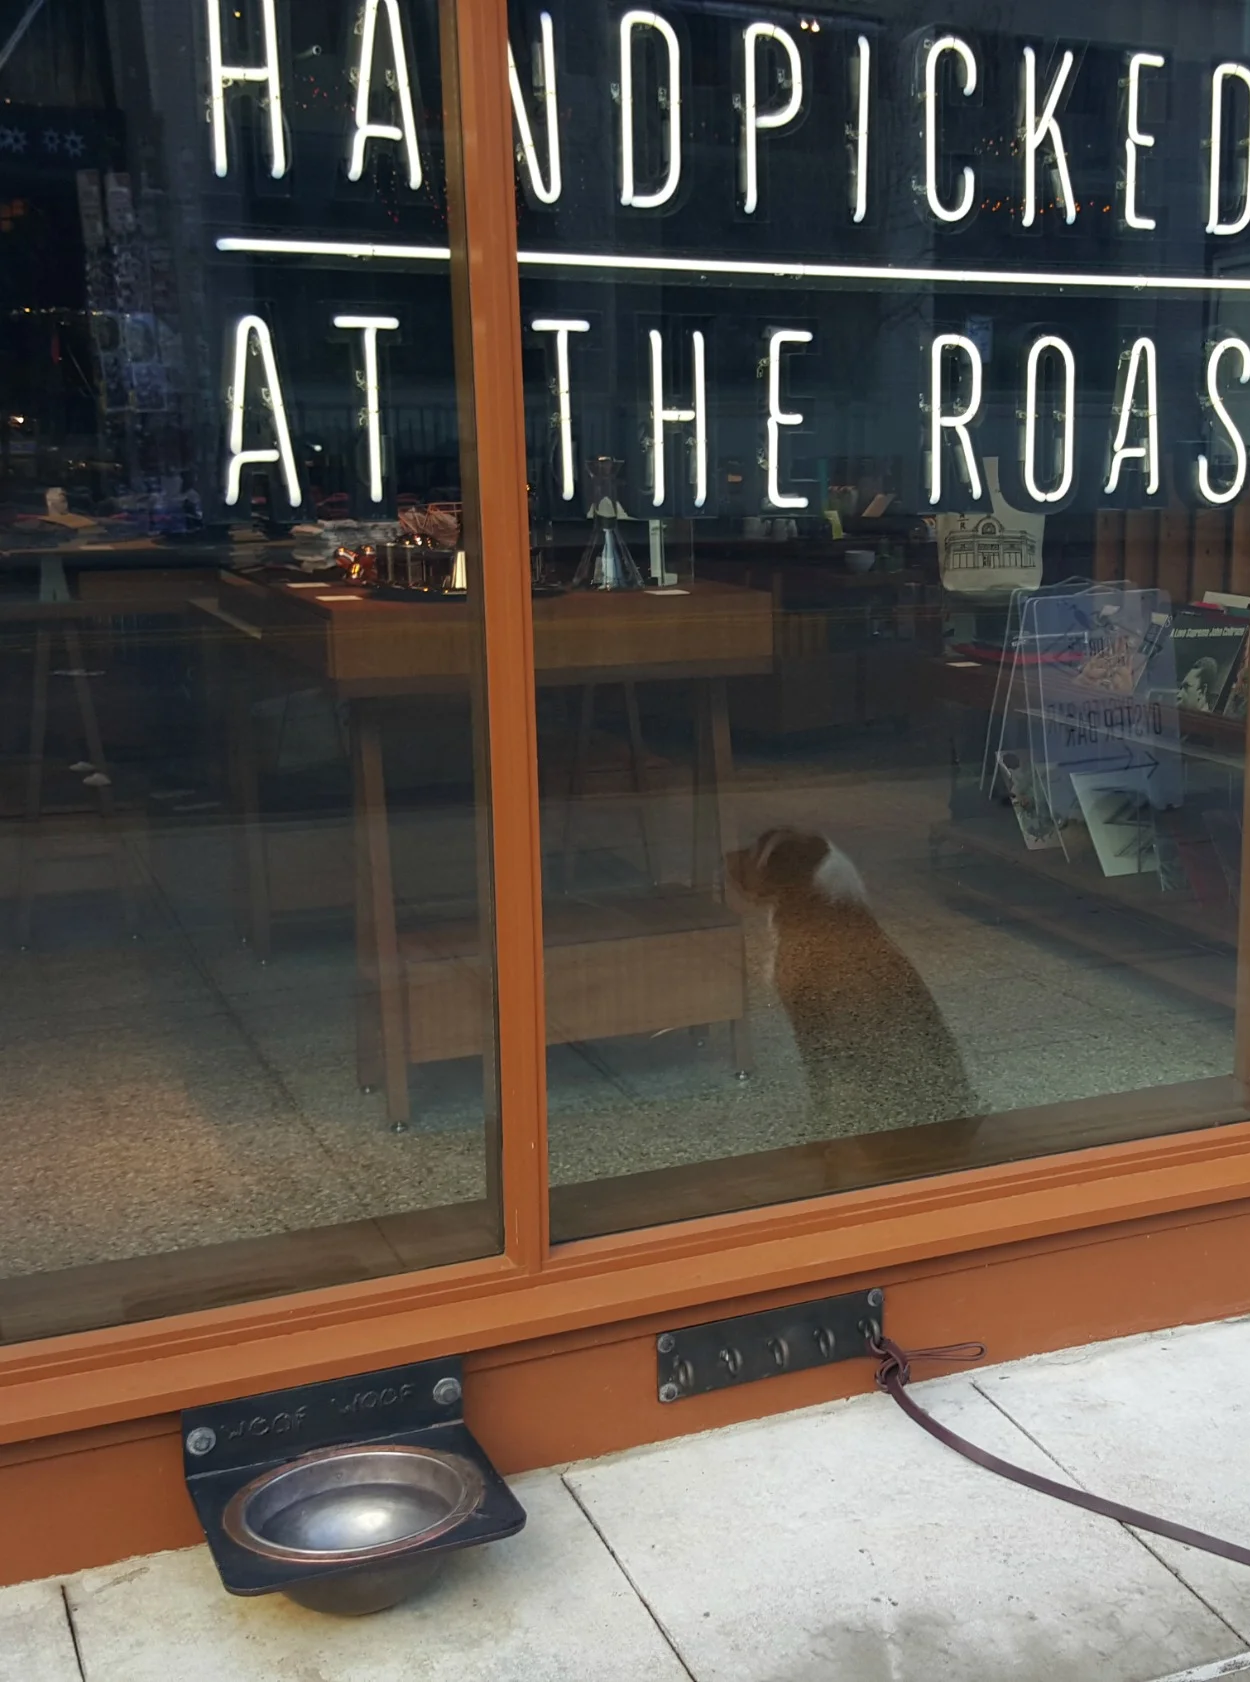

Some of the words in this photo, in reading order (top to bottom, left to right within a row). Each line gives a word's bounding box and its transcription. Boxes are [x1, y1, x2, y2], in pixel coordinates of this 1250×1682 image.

[225, 314, 400, 507] AT
[531, 319, 814, 509] THE
[330, 1382, 415, 1415] WOOF
